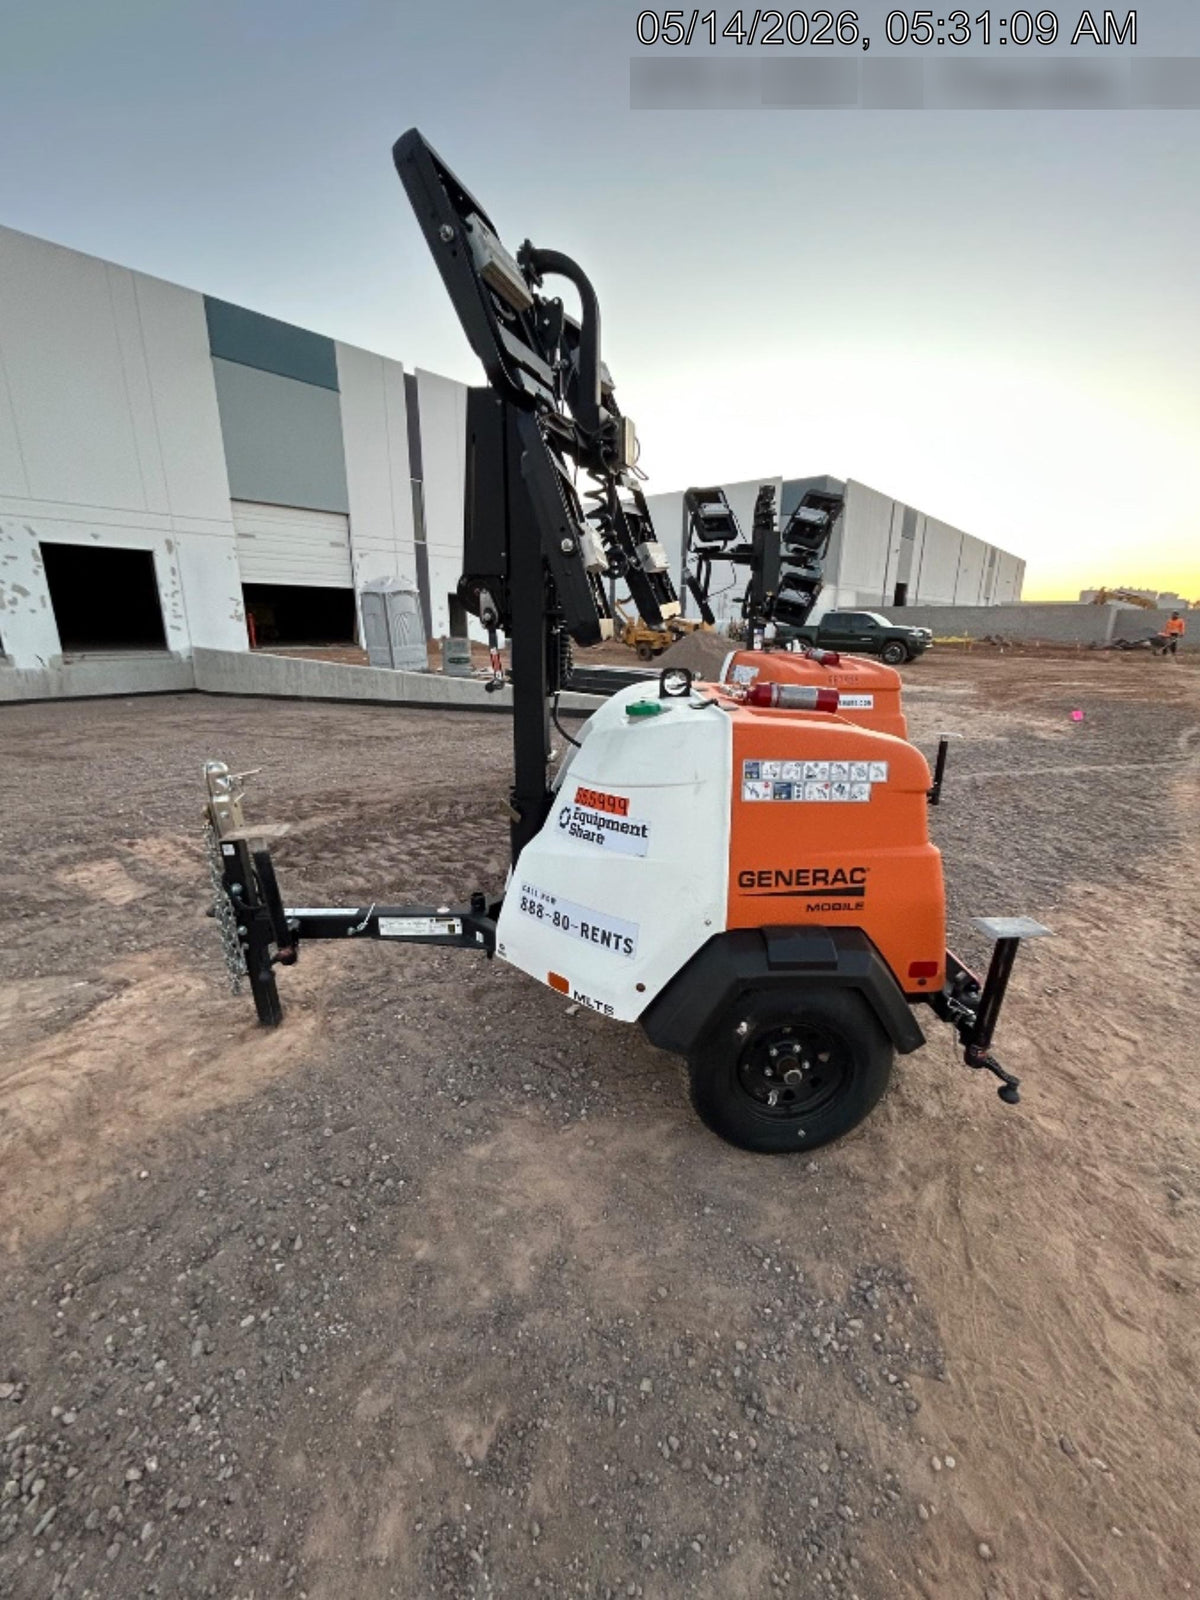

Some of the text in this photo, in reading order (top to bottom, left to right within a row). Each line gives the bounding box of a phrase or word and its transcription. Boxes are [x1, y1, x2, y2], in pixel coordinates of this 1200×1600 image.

[569, 822, 605, 845] Share
[573, 807, 648, 838] Equipment
[738, 867, 867, 888] GENERAC
[806, 902, 864, 912] MOBILE
[520, 896, 634, 954] 888-80-RENTS
